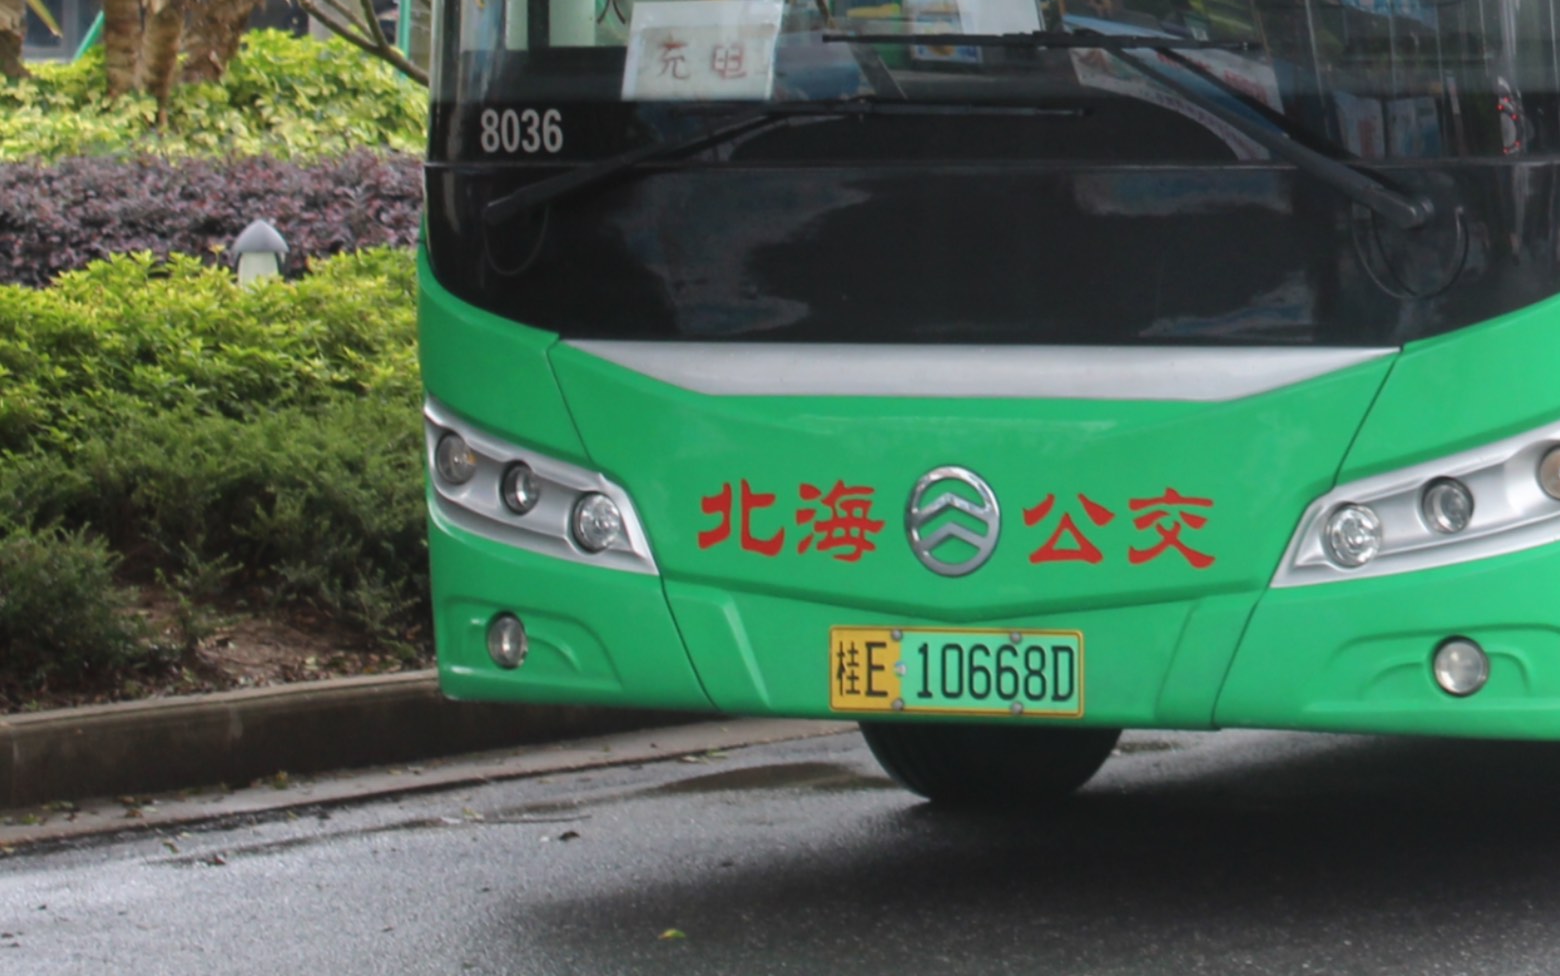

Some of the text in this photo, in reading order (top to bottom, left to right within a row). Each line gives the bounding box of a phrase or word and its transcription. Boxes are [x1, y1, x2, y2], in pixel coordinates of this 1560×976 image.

[480, 108, 563, 153] 8036
[698, 479, 1216, 568] 北海 公交
[836, 640, 1076, 703] 桂E 10668D
